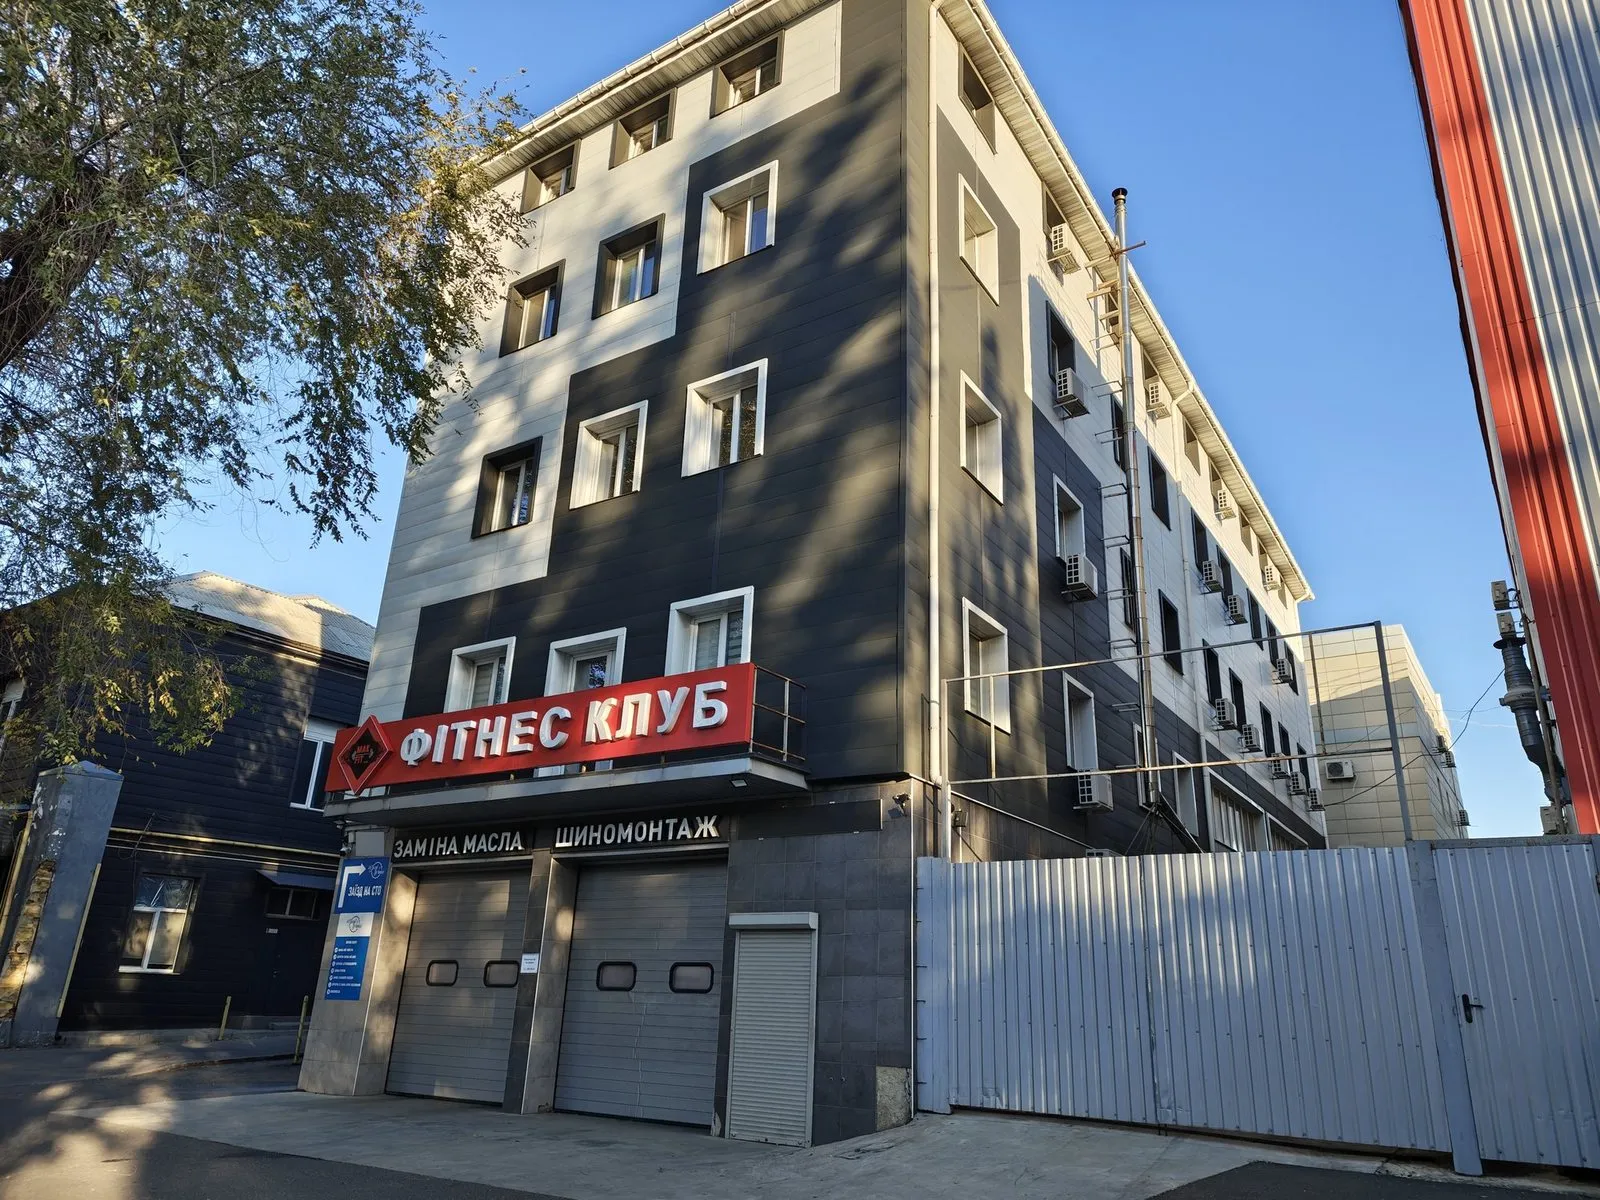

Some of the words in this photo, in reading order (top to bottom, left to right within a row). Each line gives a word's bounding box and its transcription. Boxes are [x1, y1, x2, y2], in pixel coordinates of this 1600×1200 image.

[400, 705, 572, 767] ФІТНЕС
[585, 680, 728, 744] КЛУБ
[393, 835, 460, 859] ЗАМІНА
[462, 831, 525, 853] МАСЛА
[555, 815, 719, 848] ШИНОМОНТАЖ
[347, 884, 363, 898] ЗАЇЗД
[363, 886, 370, 896] НА
[371, 885, 383, 896] СТО
